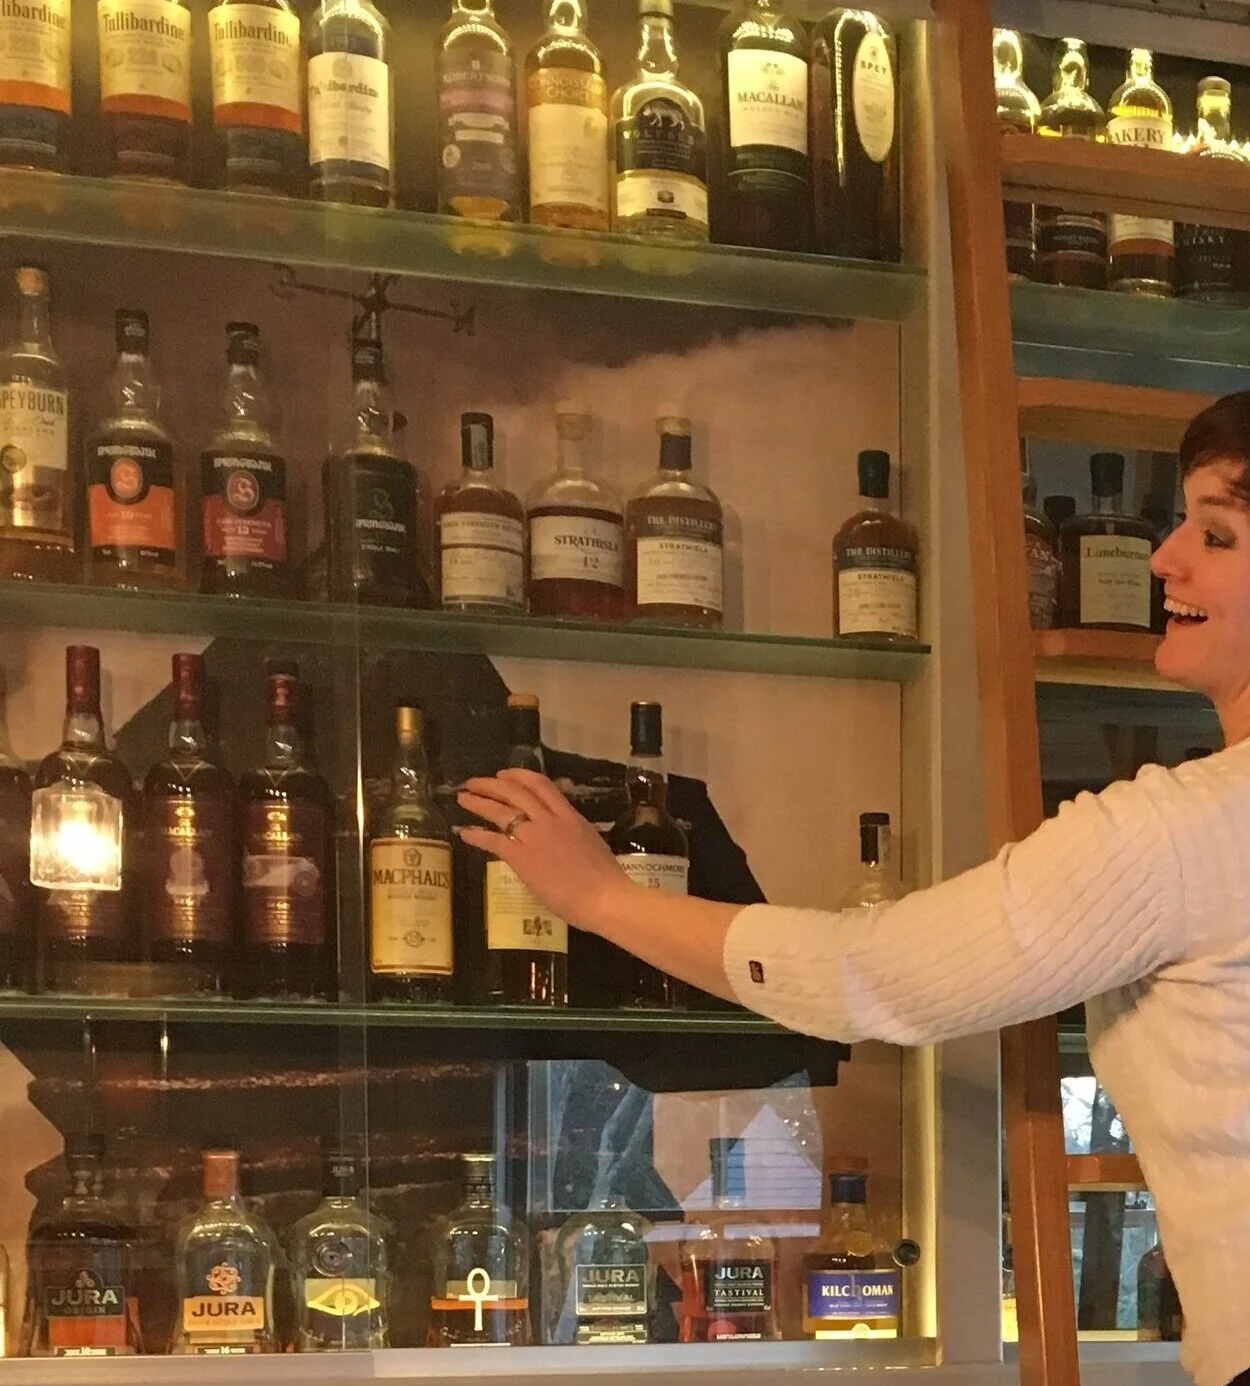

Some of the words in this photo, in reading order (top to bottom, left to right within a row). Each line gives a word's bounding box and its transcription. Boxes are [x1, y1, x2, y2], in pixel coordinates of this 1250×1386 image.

[860, 60, 887, 76] SPEY
[736, 91, 804, 110] MACALLAN
[582, 1268, 641, 1284] JURA
[714, 1265, 764, 1281] JURA
[51, 1288, 119, 1306] JURA
[714, 1287, 764, 1298] TASTIVAL
[191, 1300, 257, 1318] JURA
